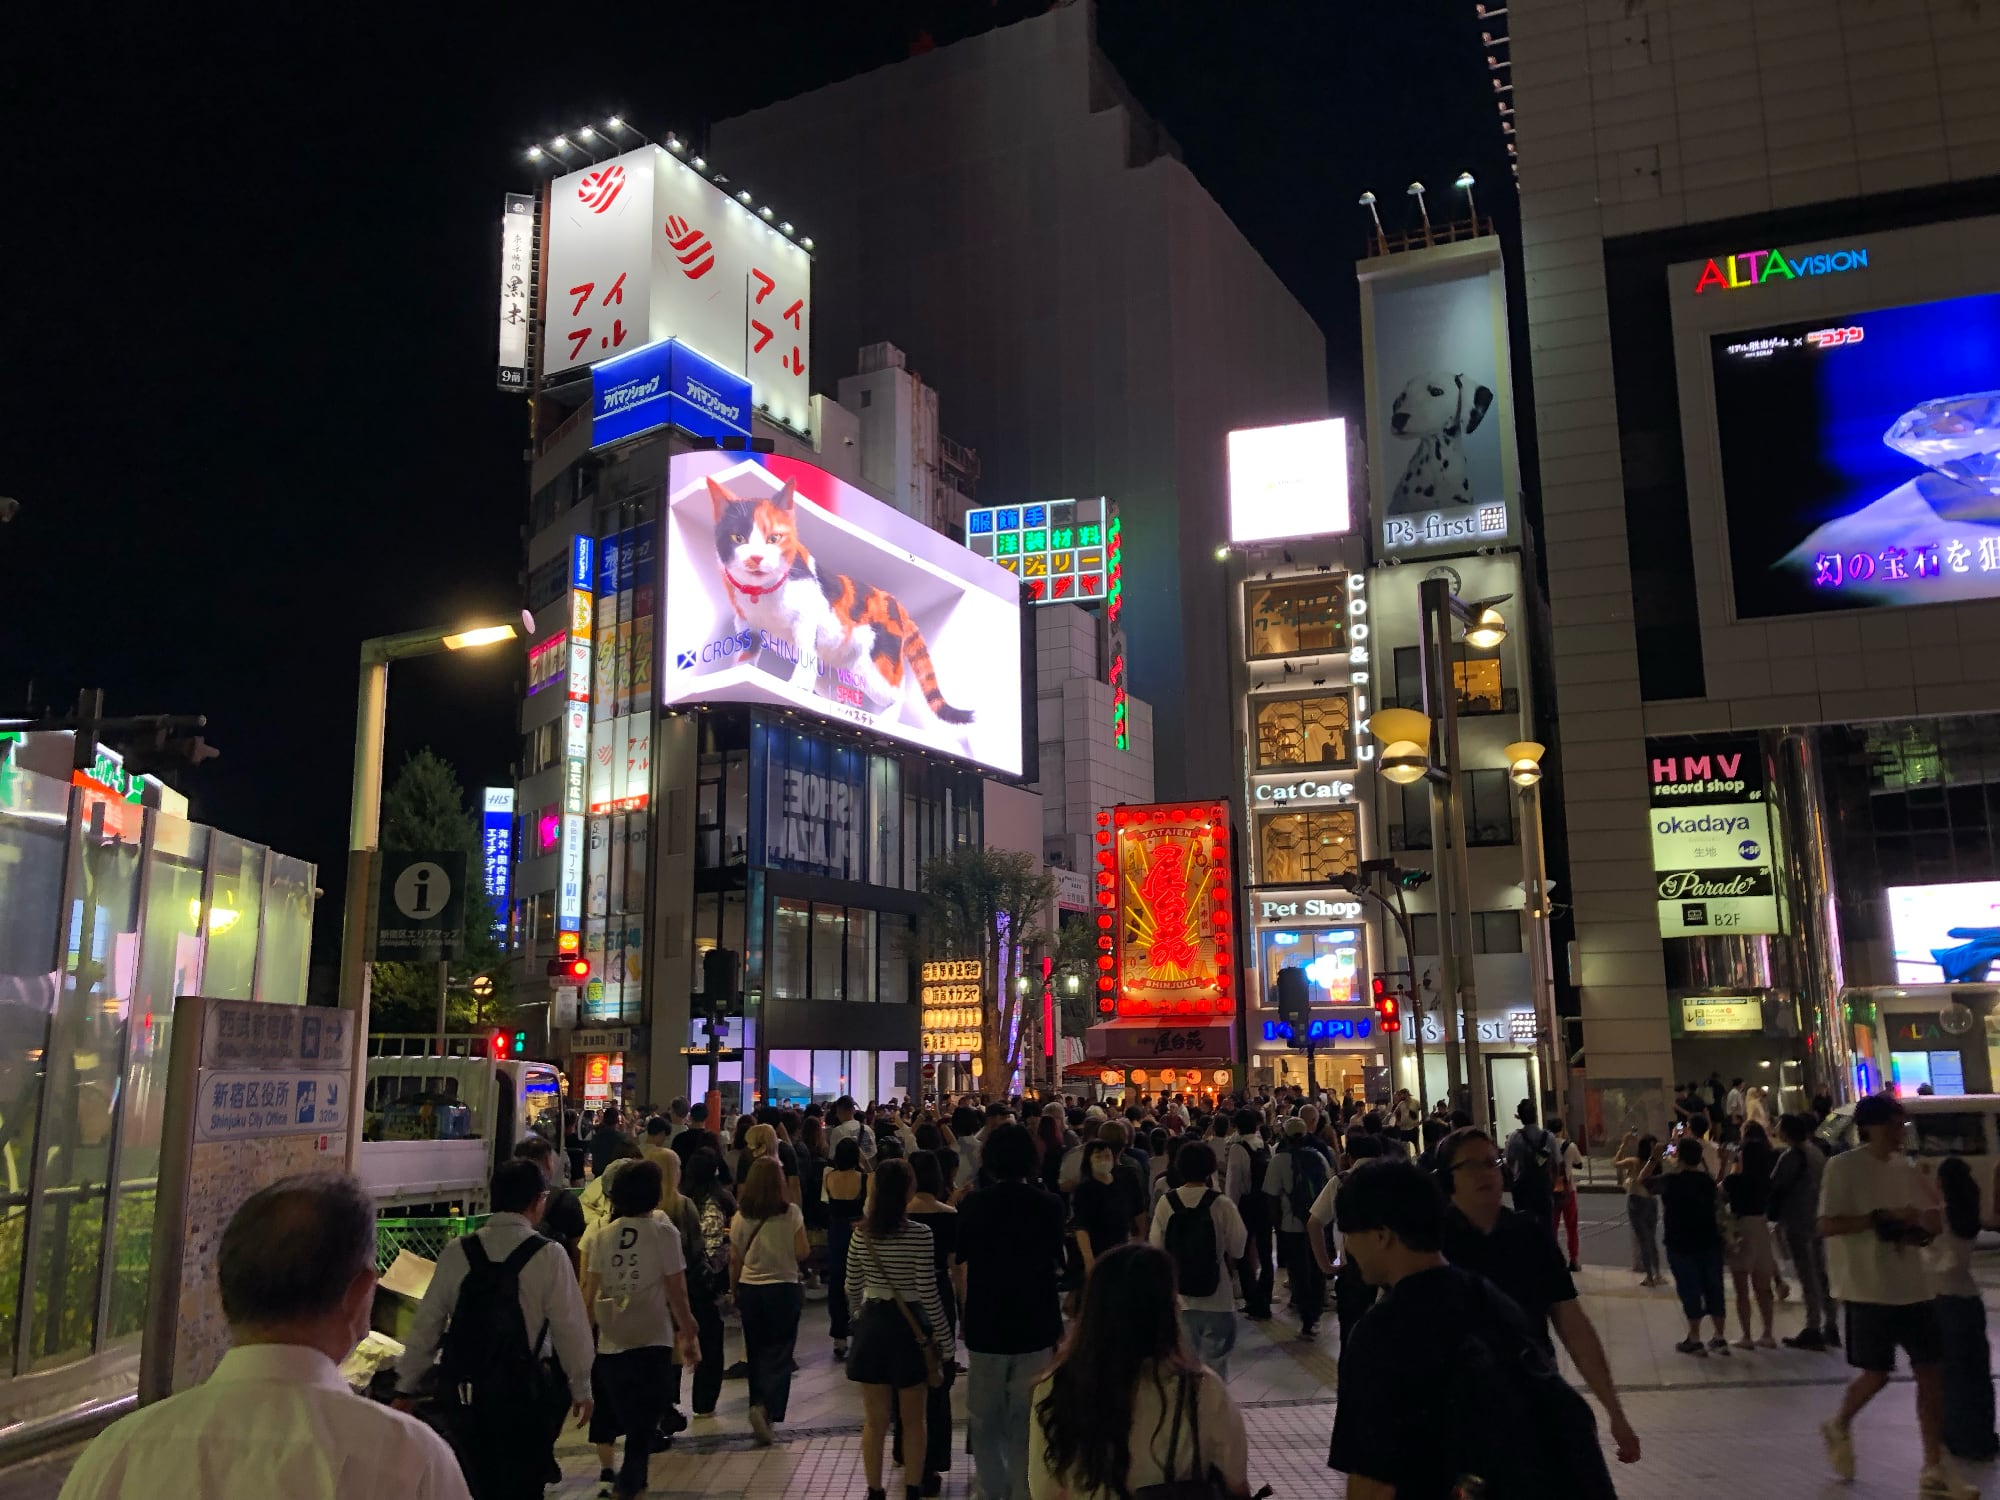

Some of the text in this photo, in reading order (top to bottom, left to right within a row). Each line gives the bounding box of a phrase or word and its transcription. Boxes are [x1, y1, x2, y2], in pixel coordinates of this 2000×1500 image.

[1695, 248, 1868, 293] ALTA VISION
[603, 375, 660, 410] アパマンショップ
[686, 381, 740, 421] アパマンショップ
[999, 524, 1101, 553] 洋装材料
[1815, 537, 2000, 587] 幻の宝石を狙
[702, 628, 824, 677] CROSS SHINJUKU
[1652, 753, 1742, 783] HMV
[1256, 780, 1354, 801] Cat Cafe
[1655, 779, 1745, 796] record shop
[1142, 829, 1193, 840] YATAIEN
[1657, 815, 1750, 836] okadaya
[1658, 871, 1757, 899] Parade
[1262, 899, 1361, 919] Pet Shop
[1714, 914, 1741, 927] B2F
[1145, 979, 1197, 989] SHINJUKU
[213, 1081, 290, 1110] 新宿区役所
[210, 1111, 289, 1131] Shinjuku City Office
[318, 1110, 339, 1123] 320m
